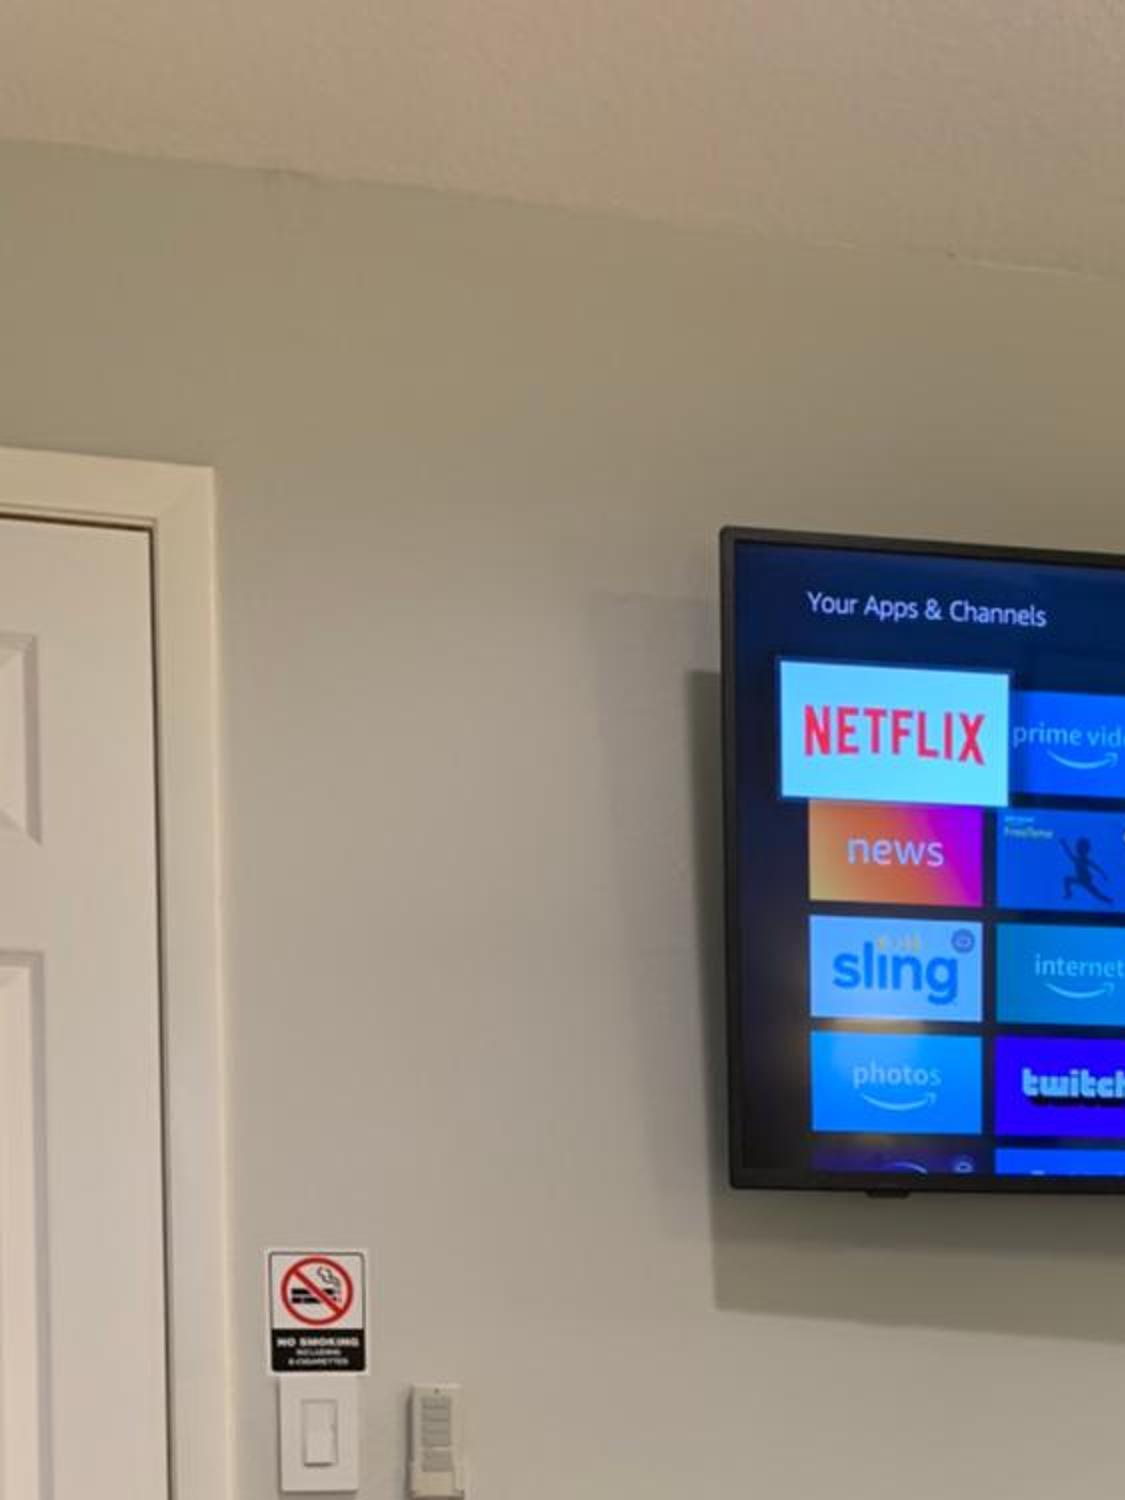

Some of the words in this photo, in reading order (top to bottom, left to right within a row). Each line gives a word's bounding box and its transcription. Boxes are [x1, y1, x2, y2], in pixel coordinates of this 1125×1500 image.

[808, 591, 857, 615] Your
[864, 595, 918, 620] Apps
[926, 600, 942, 620] &
[949, 600, 1047, 628] Channels
[803, 704, 986, 766] NETFLIX
[1012, 724, 1082, 749] prime
[847, 835, 944, 867] news
[832, 941, 959, 1006] sling
[1034, 953, 1125, 978] internet
[853, 1060, 942, 1089] photos
[277, 1337, 296, 1347] NO
[299, 1337, 359, 1347] SMOKING
